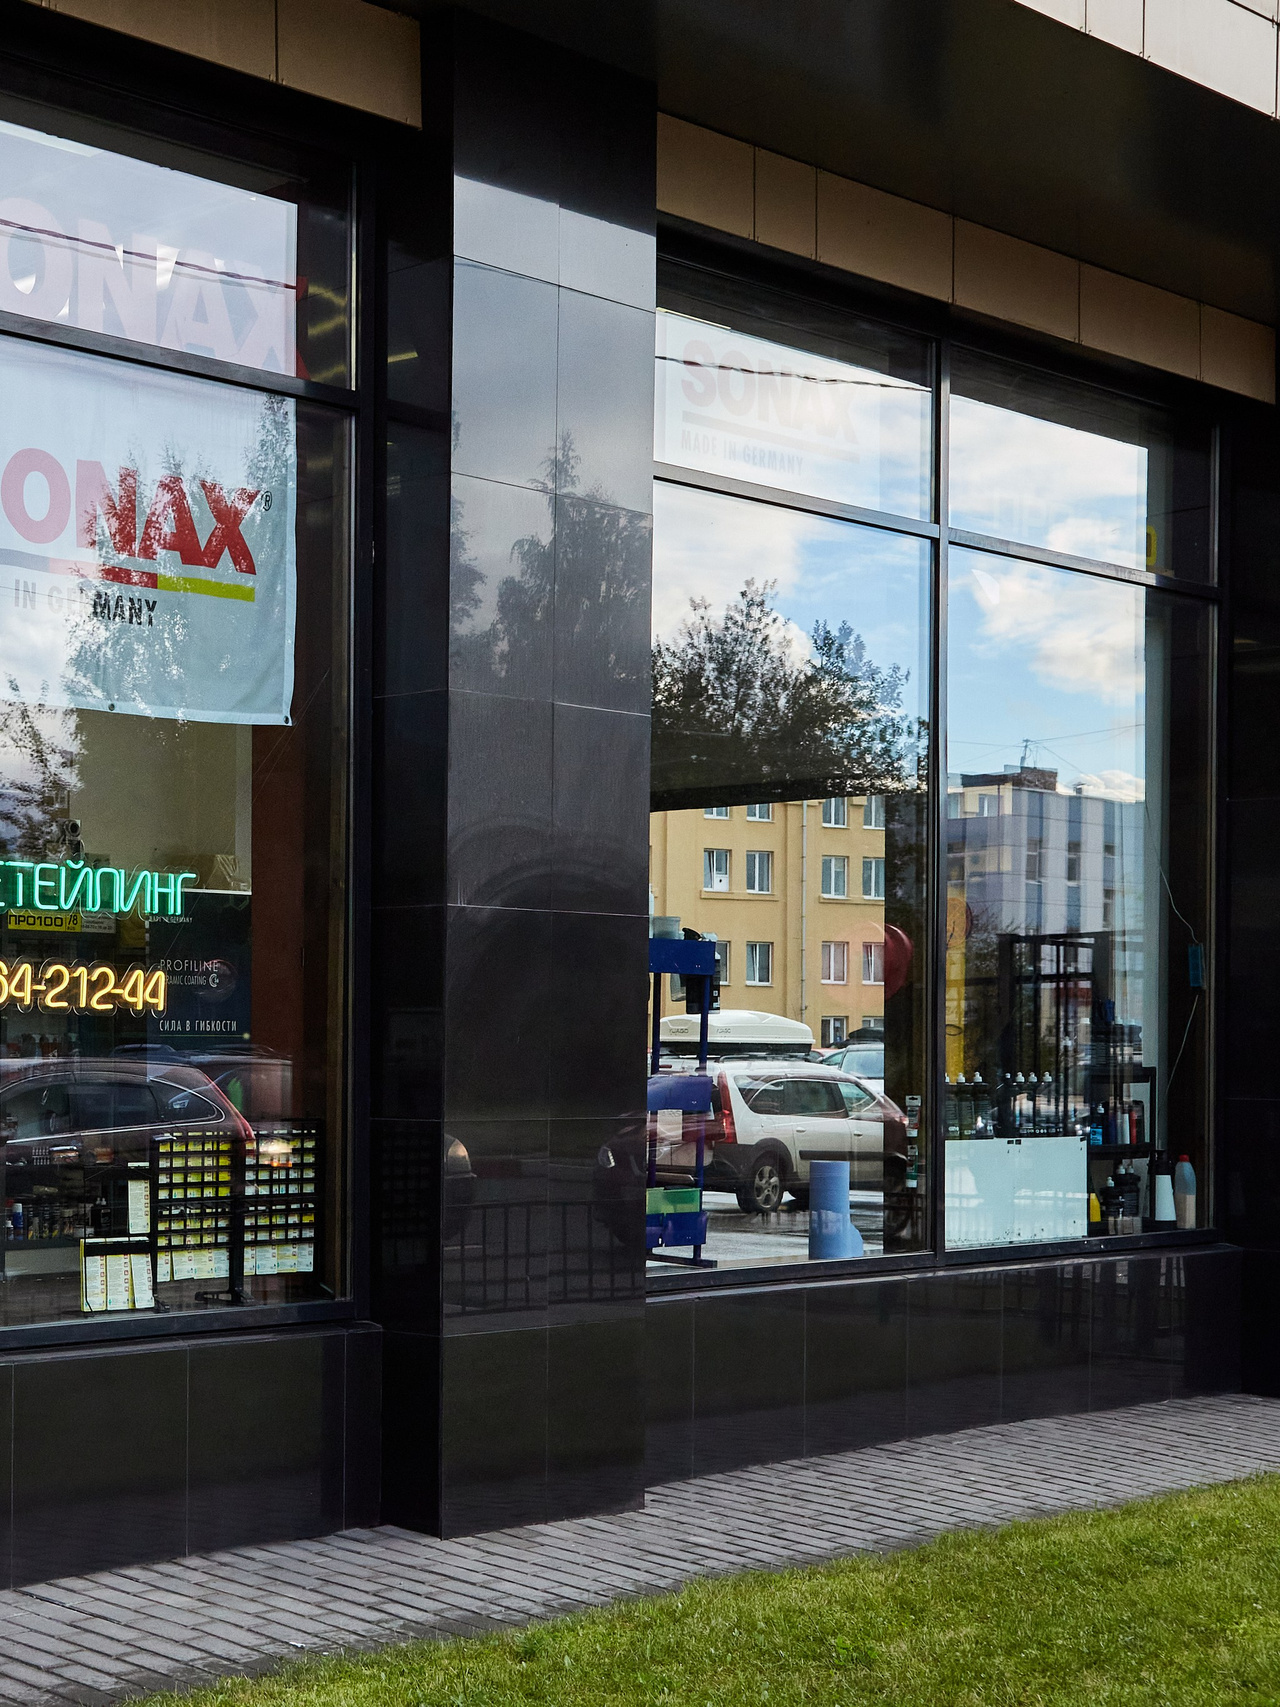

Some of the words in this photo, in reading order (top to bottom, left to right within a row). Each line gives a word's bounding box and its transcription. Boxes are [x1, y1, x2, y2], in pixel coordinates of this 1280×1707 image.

[681, 340, 858, 444] SONAX
[681, 429, 717, 457] MADE
[723, 438, 737, 462] IN
[742, 443, 804, 476] GERMANY
[14, 578, 37, 610] IN
[8, 914, 63, 927] ПРО100
[159, 959, 219, 973] PROFILINE
[184, 975, 206, 985] COATING
[159, 1020, 182, 1032] СИЛА
[185, 1020, 191, 1031] В
[195, 1020, 237, 1032] ГИБКОСТИ
